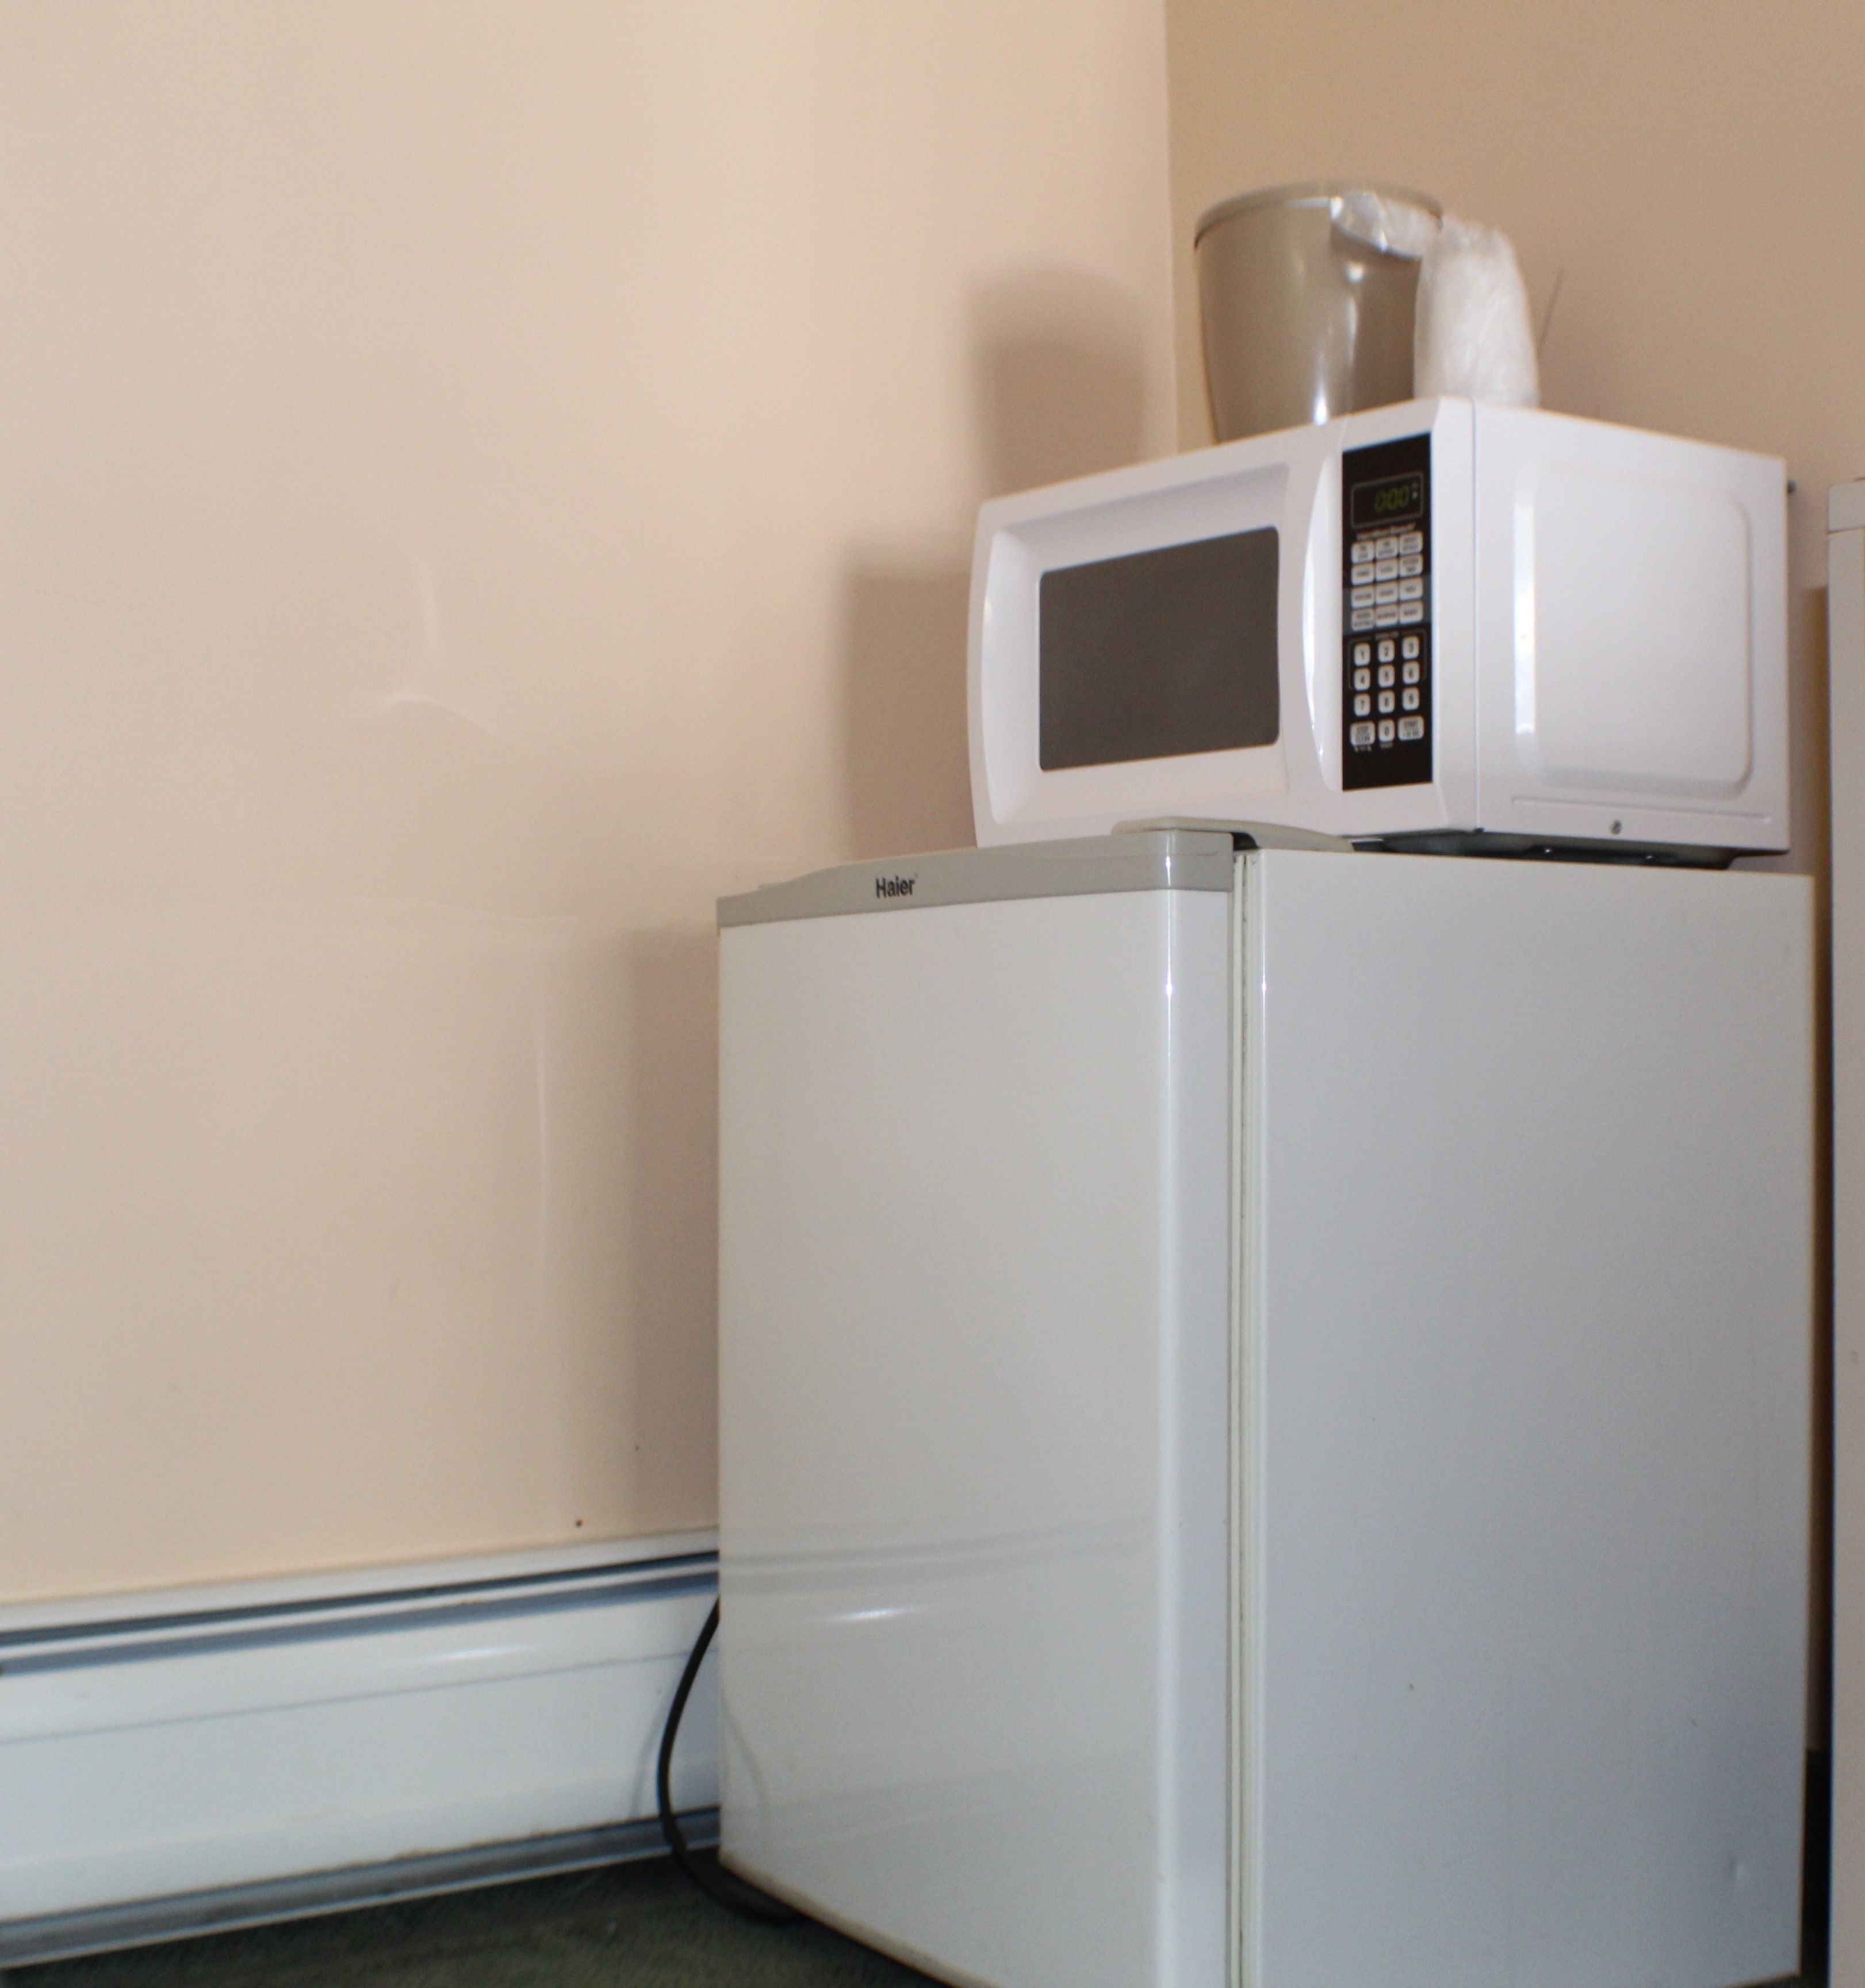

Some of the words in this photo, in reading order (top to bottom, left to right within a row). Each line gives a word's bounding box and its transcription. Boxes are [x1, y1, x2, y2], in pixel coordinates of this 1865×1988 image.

[1384, 646, 1389, 657] 2
[1361, 699, 1365, 711] 7
[1384, 725, 1389, 737] 0
[876, 874, 915, 899] Haier
